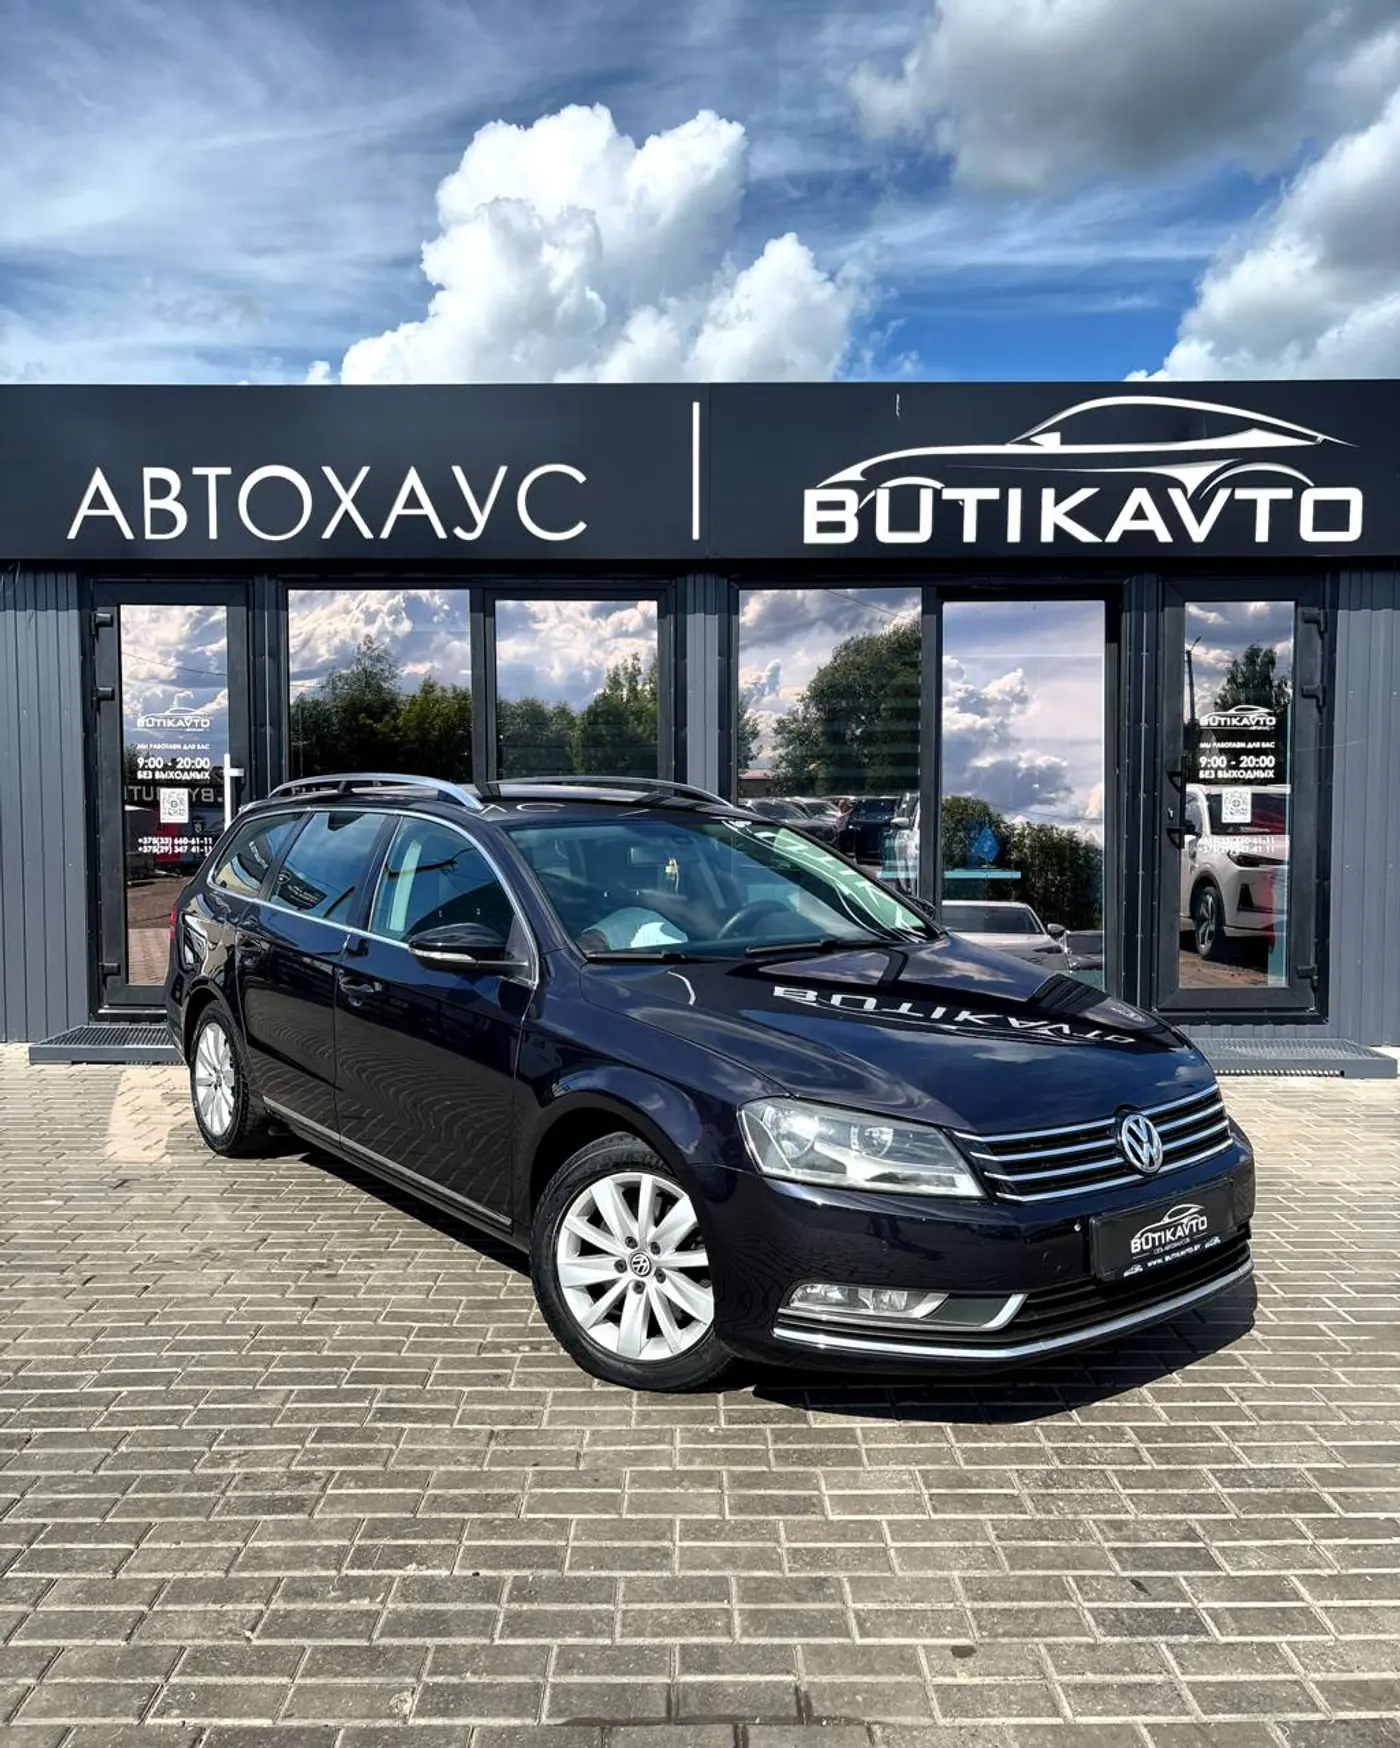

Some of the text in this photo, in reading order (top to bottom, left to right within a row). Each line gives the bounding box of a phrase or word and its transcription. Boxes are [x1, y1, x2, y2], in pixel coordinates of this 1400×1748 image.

[67, 463, 588, 541] АВТОХАУС
[803, 487, 1363, 544] BUTIKAVTO
[136, 718, 211, 728] BUTIKAVTO
[1199, 716, 1276, 726] BUTIKAVTO
[137, 757, 164, 769] 9:00
[176, 757, 210, 769] 20:00
[1200, 756, 1227, 768] 9:00
[1239, 755, 1275, 768] 20:00
[137, 770, 211, 781] БЕЗ ВЫХОДНЫХ
[1199, 769, 1275, 780] БЕЗ ВЫХОДНЫХ
[1130, 1214, 1208, 1254] BUTIKAVTO
